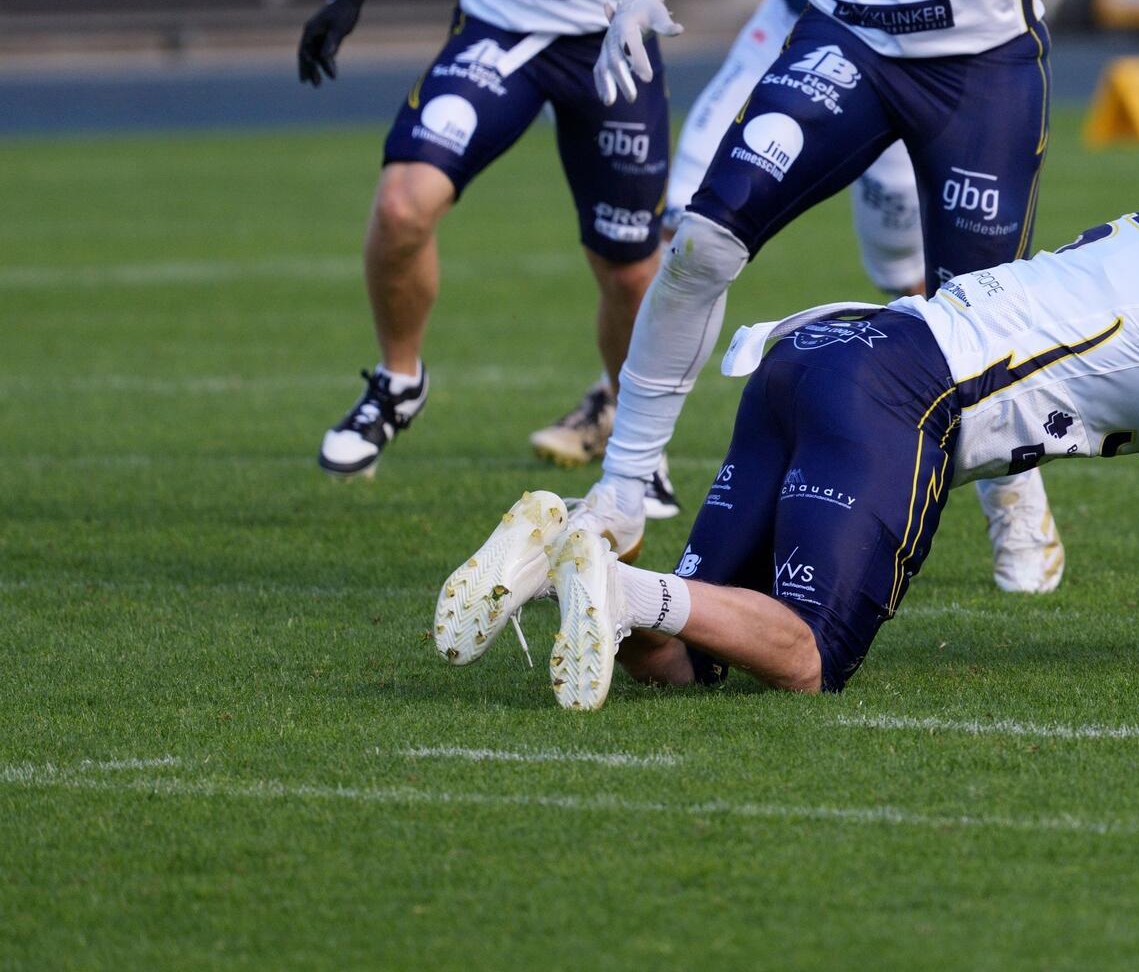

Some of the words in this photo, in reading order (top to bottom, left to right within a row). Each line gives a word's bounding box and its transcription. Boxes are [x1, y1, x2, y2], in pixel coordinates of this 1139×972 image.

[762, 73, 844, 115] Schreyer
[802, 73, 841, 102] Holz
[598, 129, 650, 164] gbg
[763, 140, 790, 167] Jim
[731, 146, 785, 183] Fitnessclub
[943, 178, 999, 221] gbg
[781, 483, 856, 505] chaudry
